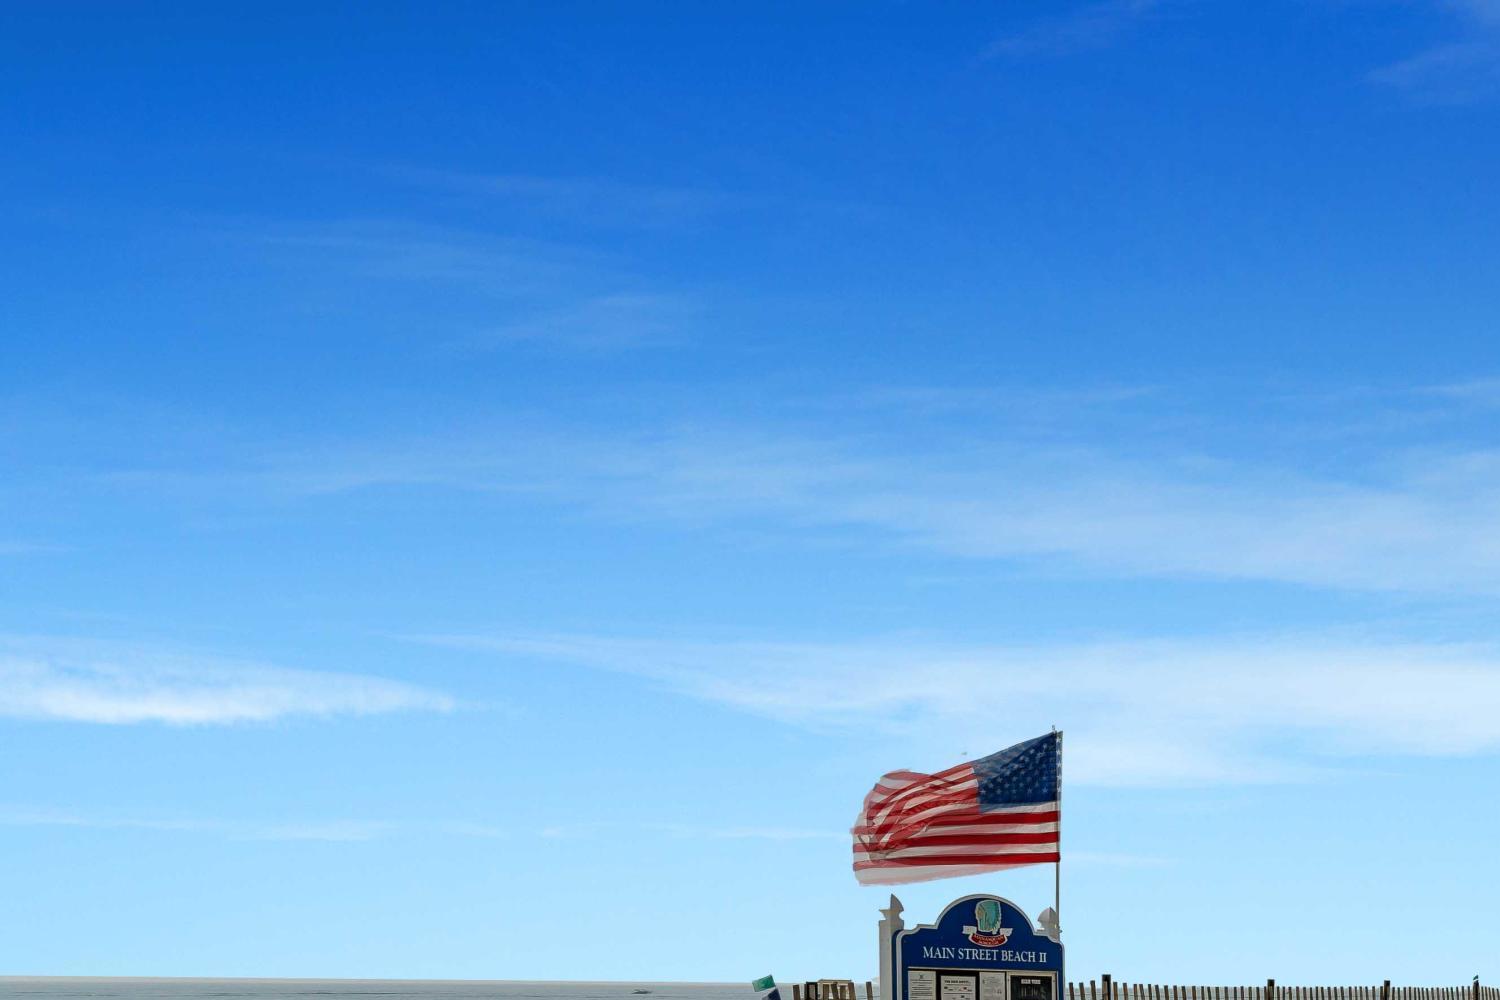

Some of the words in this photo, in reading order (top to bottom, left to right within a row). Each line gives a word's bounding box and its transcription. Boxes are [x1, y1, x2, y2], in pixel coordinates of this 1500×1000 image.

[923, 946, 955, 959] MAIN
[958, 947, 999, 961] STREET
[1001, 950, 1036, 963] BEACH
[1038, 952, 1047, 963] II
